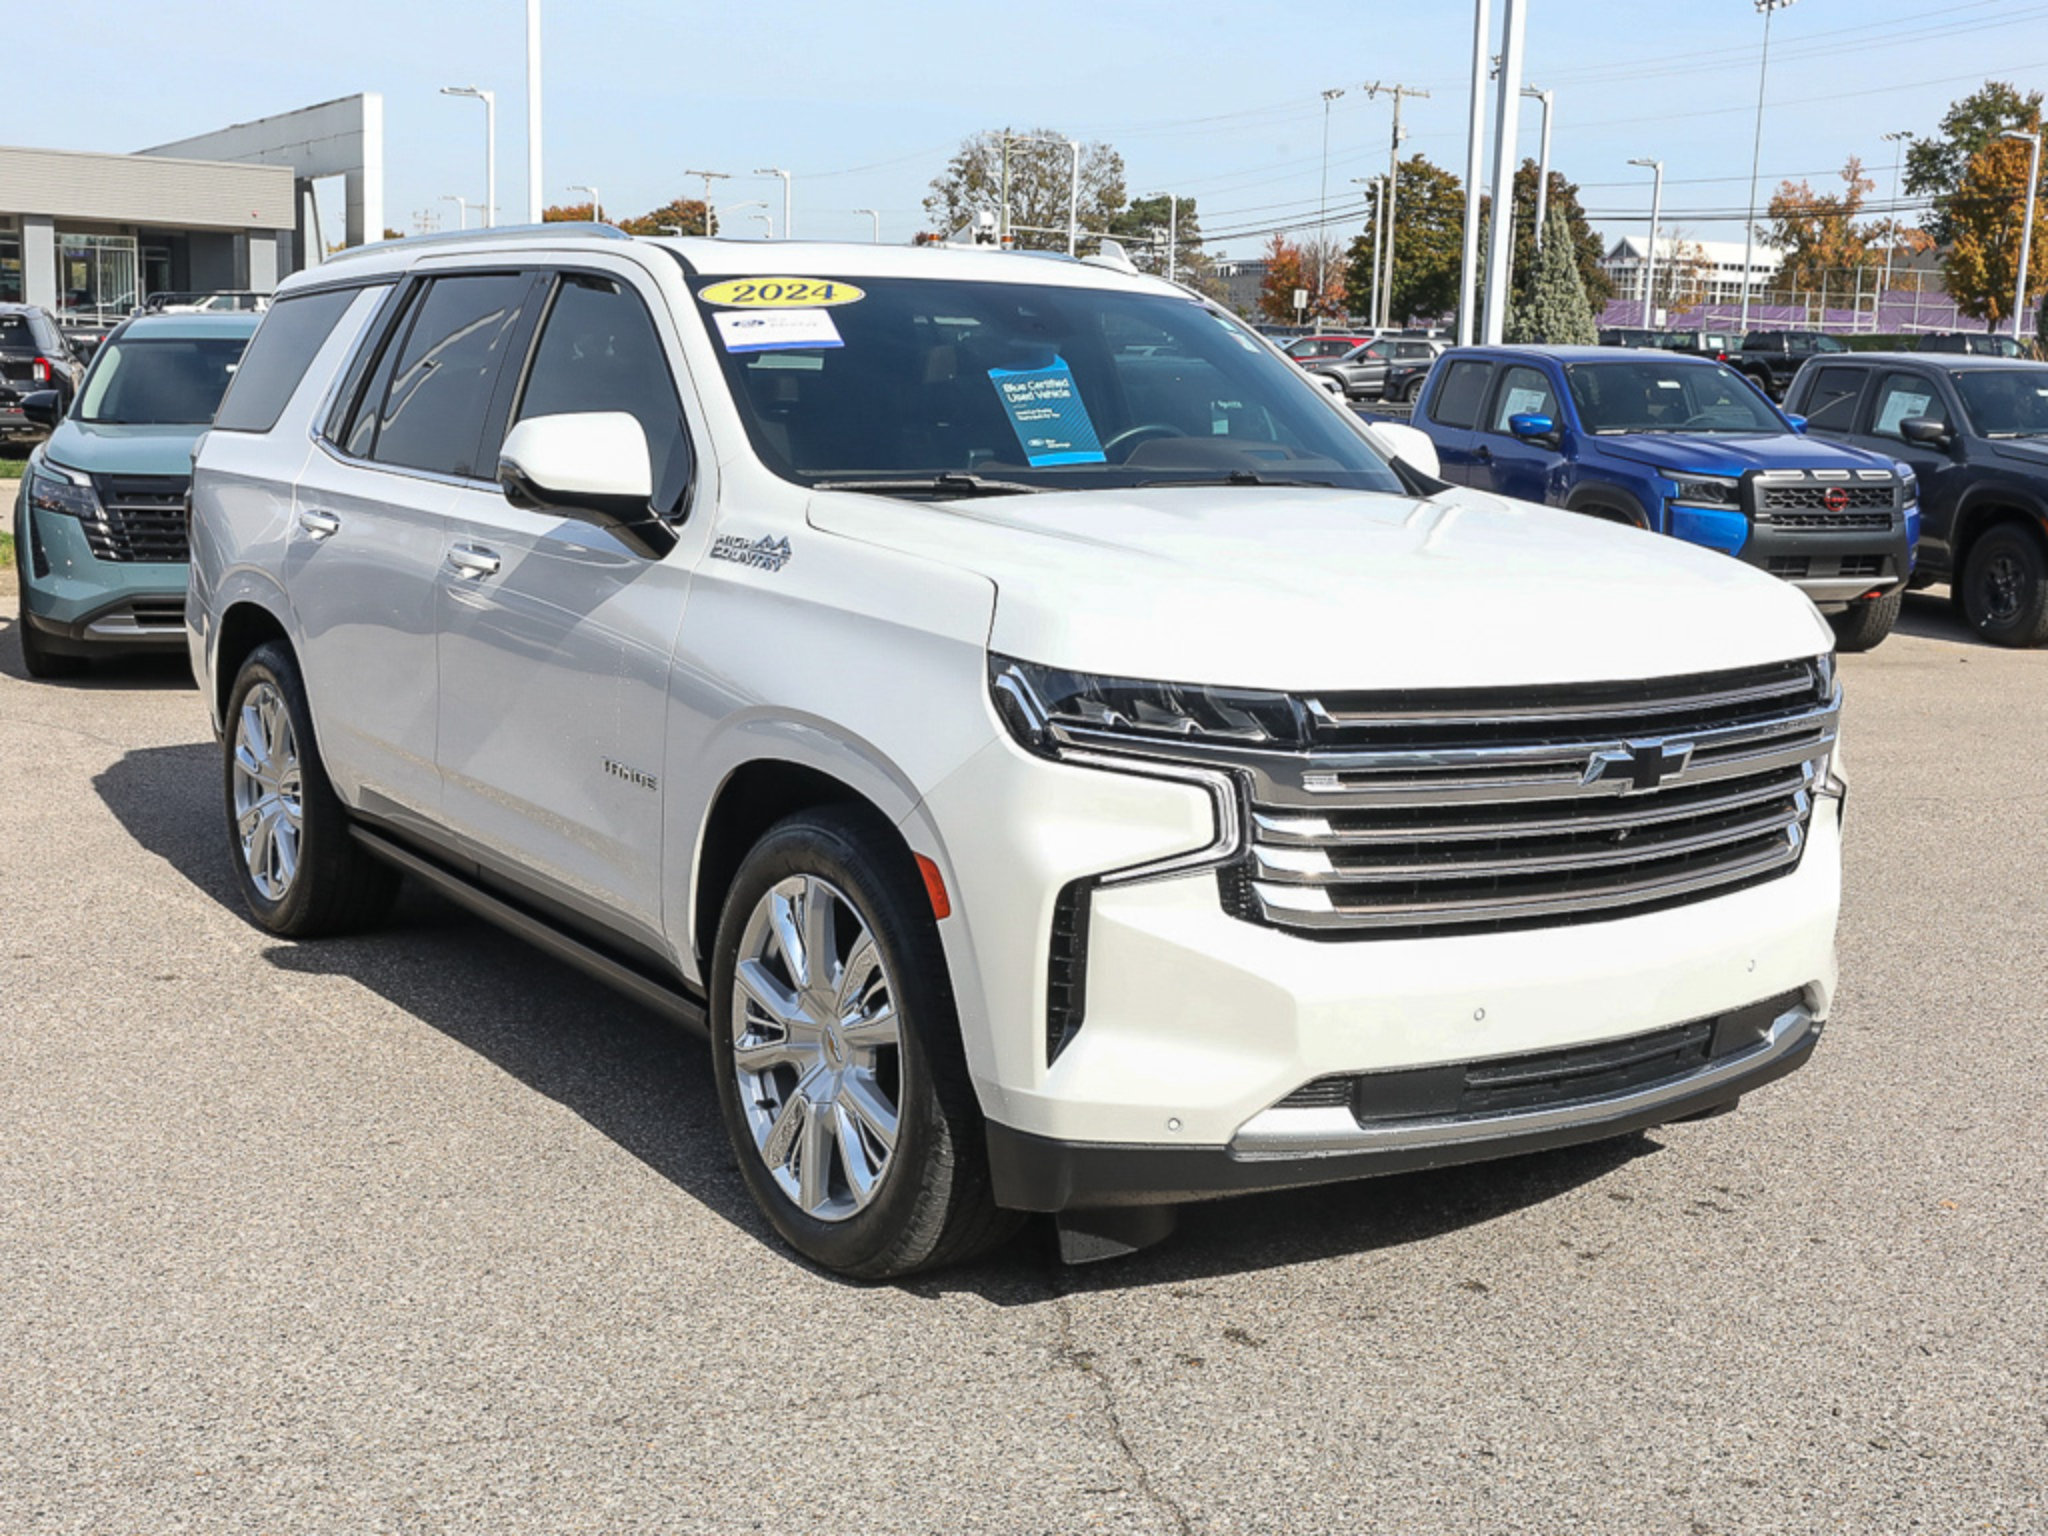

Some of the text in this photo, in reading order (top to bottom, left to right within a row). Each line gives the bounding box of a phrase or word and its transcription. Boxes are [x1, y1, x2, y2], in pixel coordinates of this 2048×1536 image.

[732, 284, 837, 302] 2024
[1002, 378, 1070, 393] Blue Certified
[1006, 388, 1071, 402] Used Vehicle
[710, 545, 786, 572] COUNTRY
